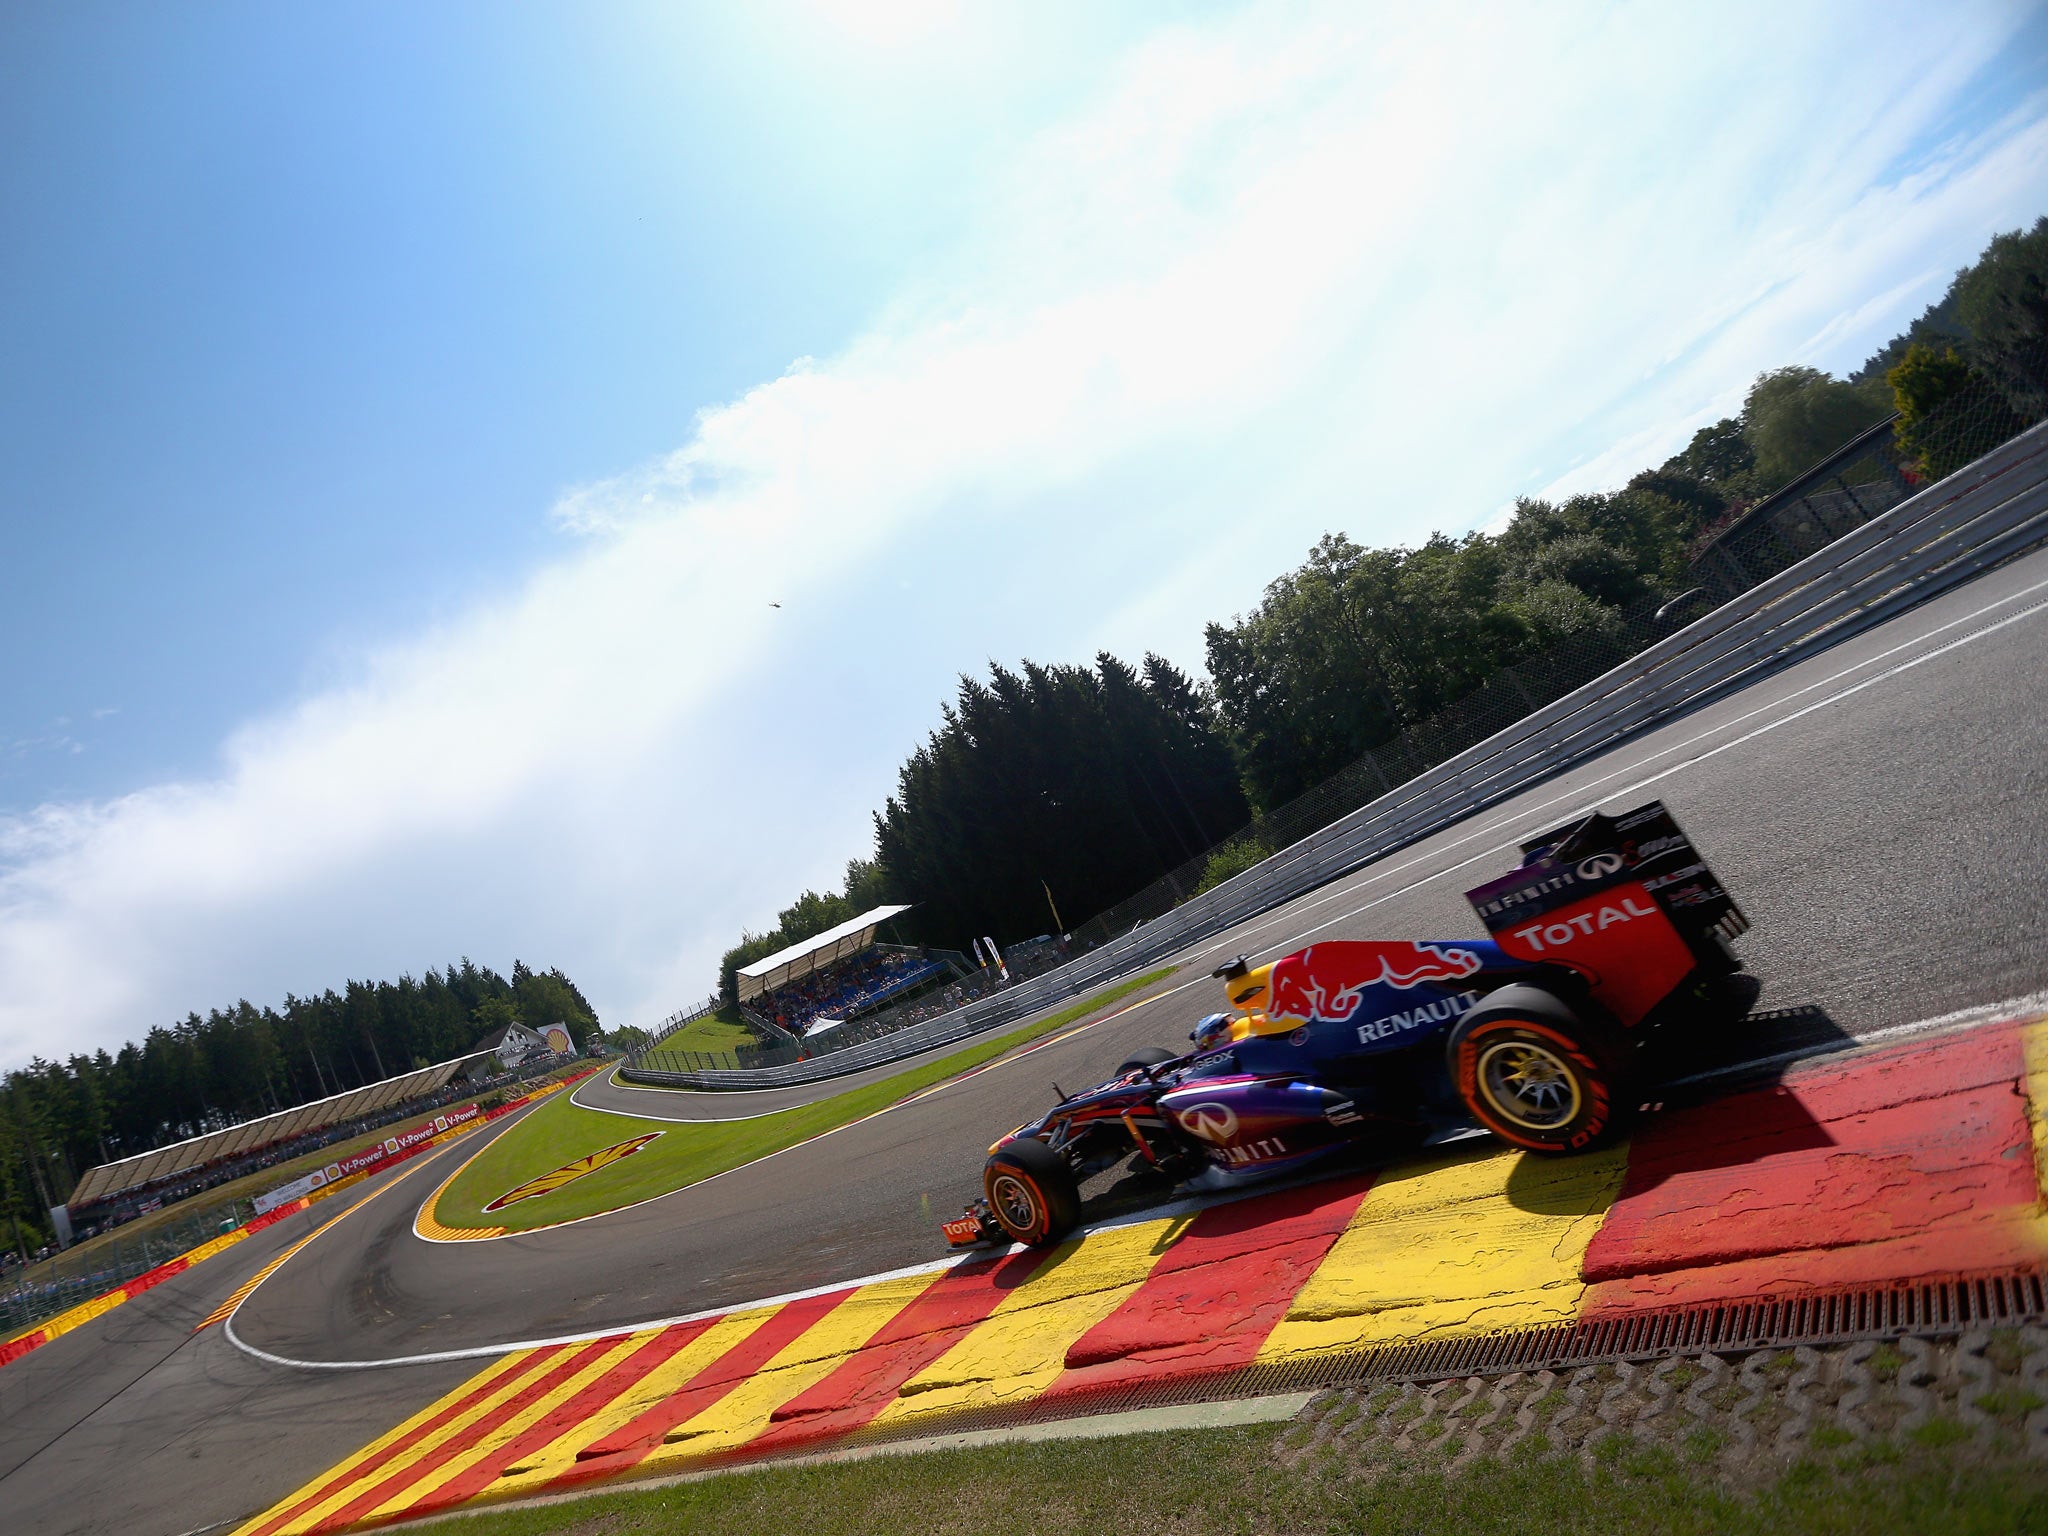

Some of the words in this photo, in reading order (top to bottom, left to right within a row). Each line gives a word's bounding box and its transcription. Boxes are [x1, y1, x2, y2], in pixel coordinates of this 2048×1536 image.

[1477, 873, 1575, 917] INFINITI
[1513, 898, 1657, 951] TOTAL
[1356, 989, 1480, 1045] RENAULT
[1194, 1050, 1235, 1071] GEOX
[447, 1108, 478, 1126] V-Power
[398, 1127, 434, 1147] V-Power
[341, 1150, 383, 1174] V-Power
[1208, 1137, 1287, 1163] FINITI
